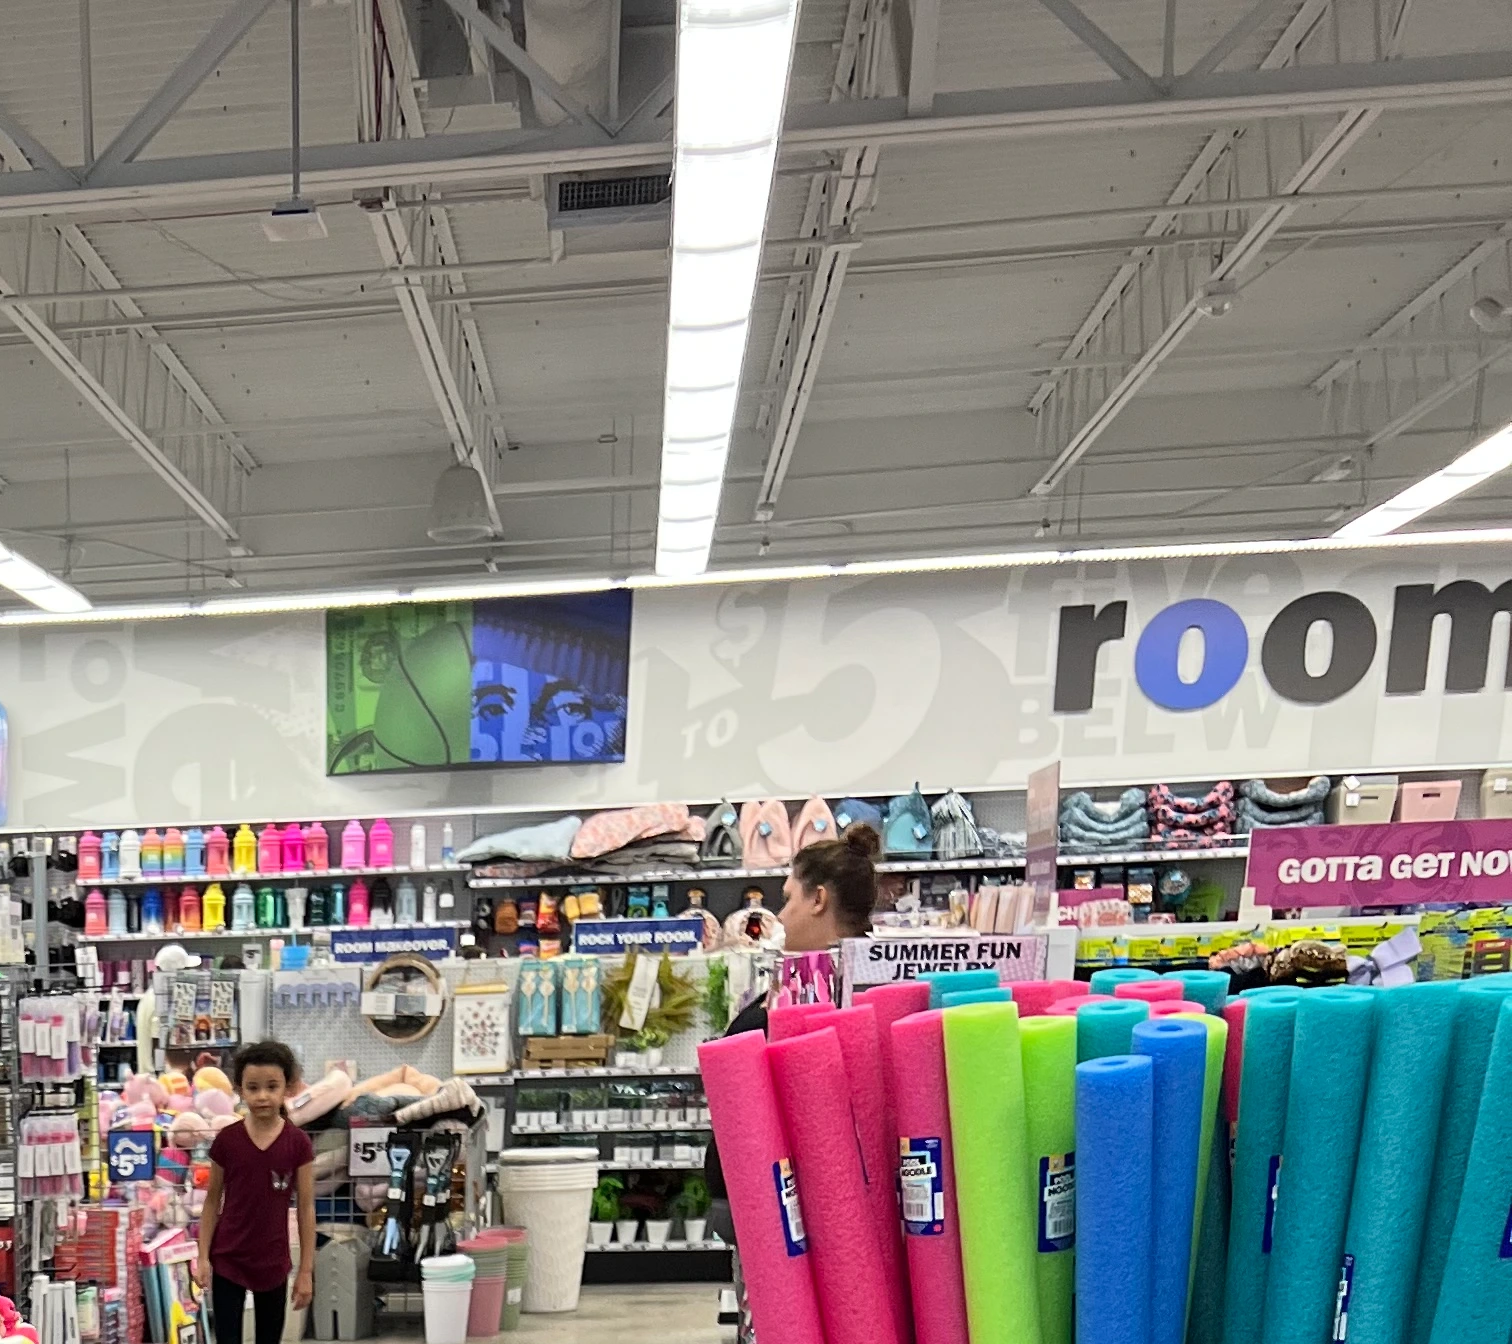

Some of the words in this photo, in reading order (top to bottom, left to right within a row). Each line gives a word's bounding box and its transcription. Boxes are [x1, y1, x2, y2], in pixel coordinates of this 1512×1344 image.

[577, 933, 615, 946] ROCK
[334, 941, 373, 955] ROOM
[868, 942, 972, 962] SUMMER
[976, 941, 1022, 960] FUN
